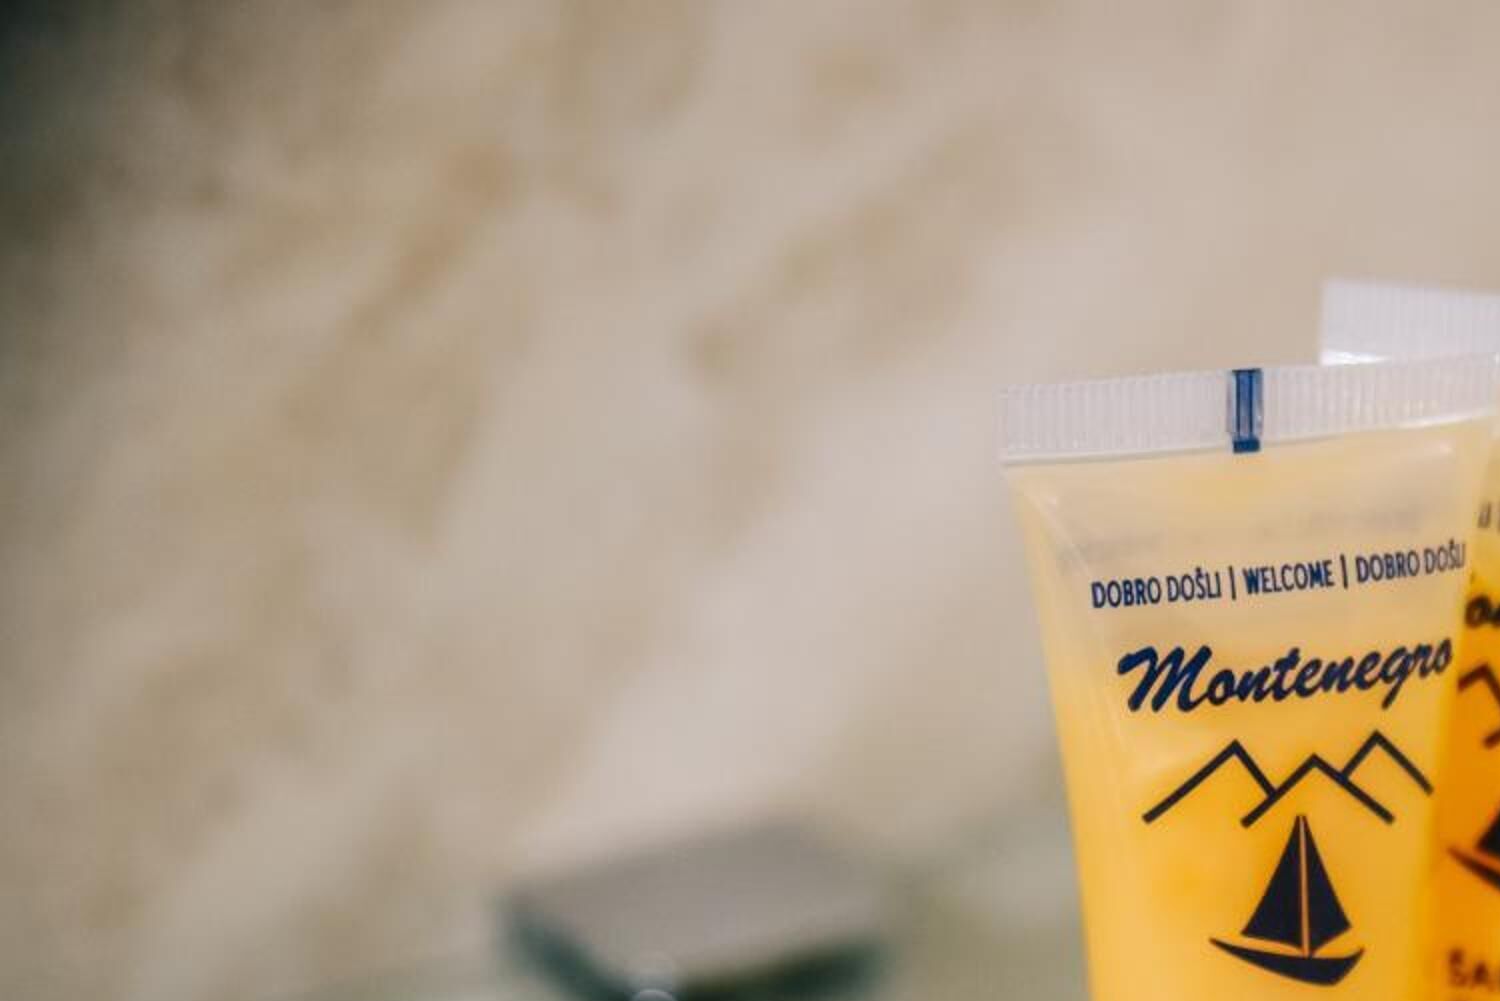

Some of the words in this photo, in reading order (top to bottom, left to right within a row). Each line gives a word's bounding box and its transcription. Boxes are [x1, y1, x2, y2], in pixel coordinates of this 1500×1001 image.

[1091, 577, 1162, 608] DOBRO
[1167, 567, 1221, 602] DOŠLI
[1243, 559, 1335, 595] WELCOME
[1356, 549, 1420, 583] DOBRO
[1423, 538, 1466, 575] DOŠLI
[1117, 638, 1453, 713] Montenegro
